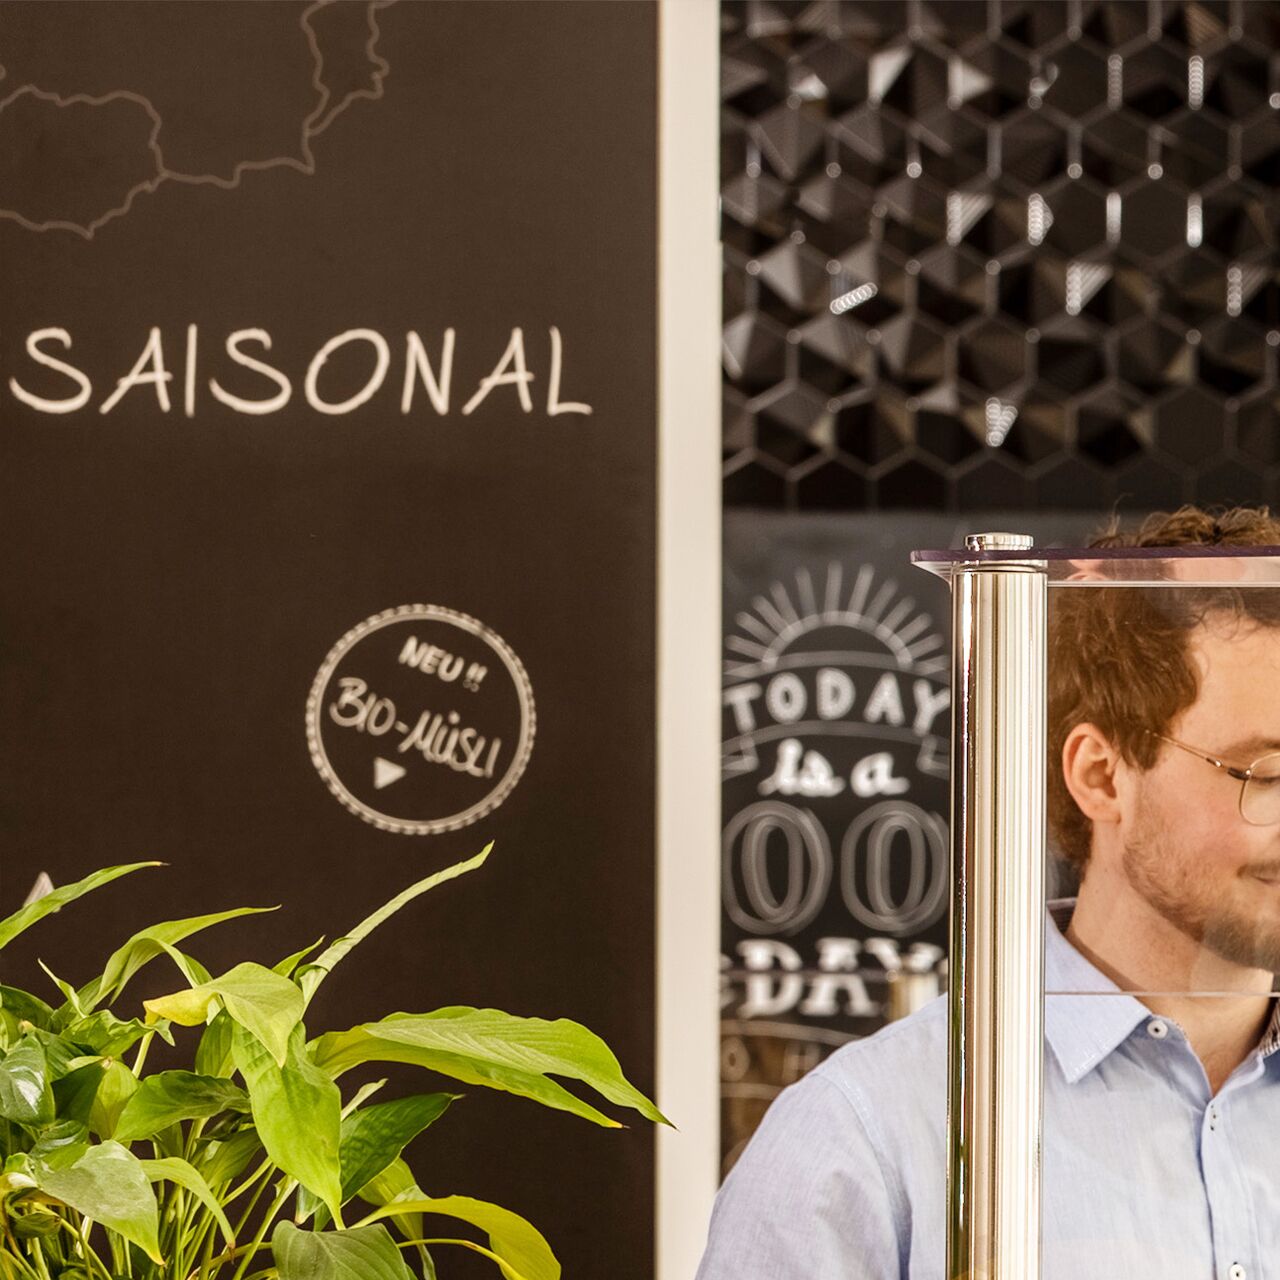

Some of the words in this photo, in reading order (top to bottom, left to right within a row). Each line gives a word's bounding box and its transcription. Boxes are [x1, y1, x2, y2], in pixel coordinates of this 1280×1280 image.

[9, 322, 594, 418] SAISONAL
[329, 676, 502, 779] BIO-MÜSLI
[723, 667, 949, 737] TODAY
[849, 751, 910, 799] a
